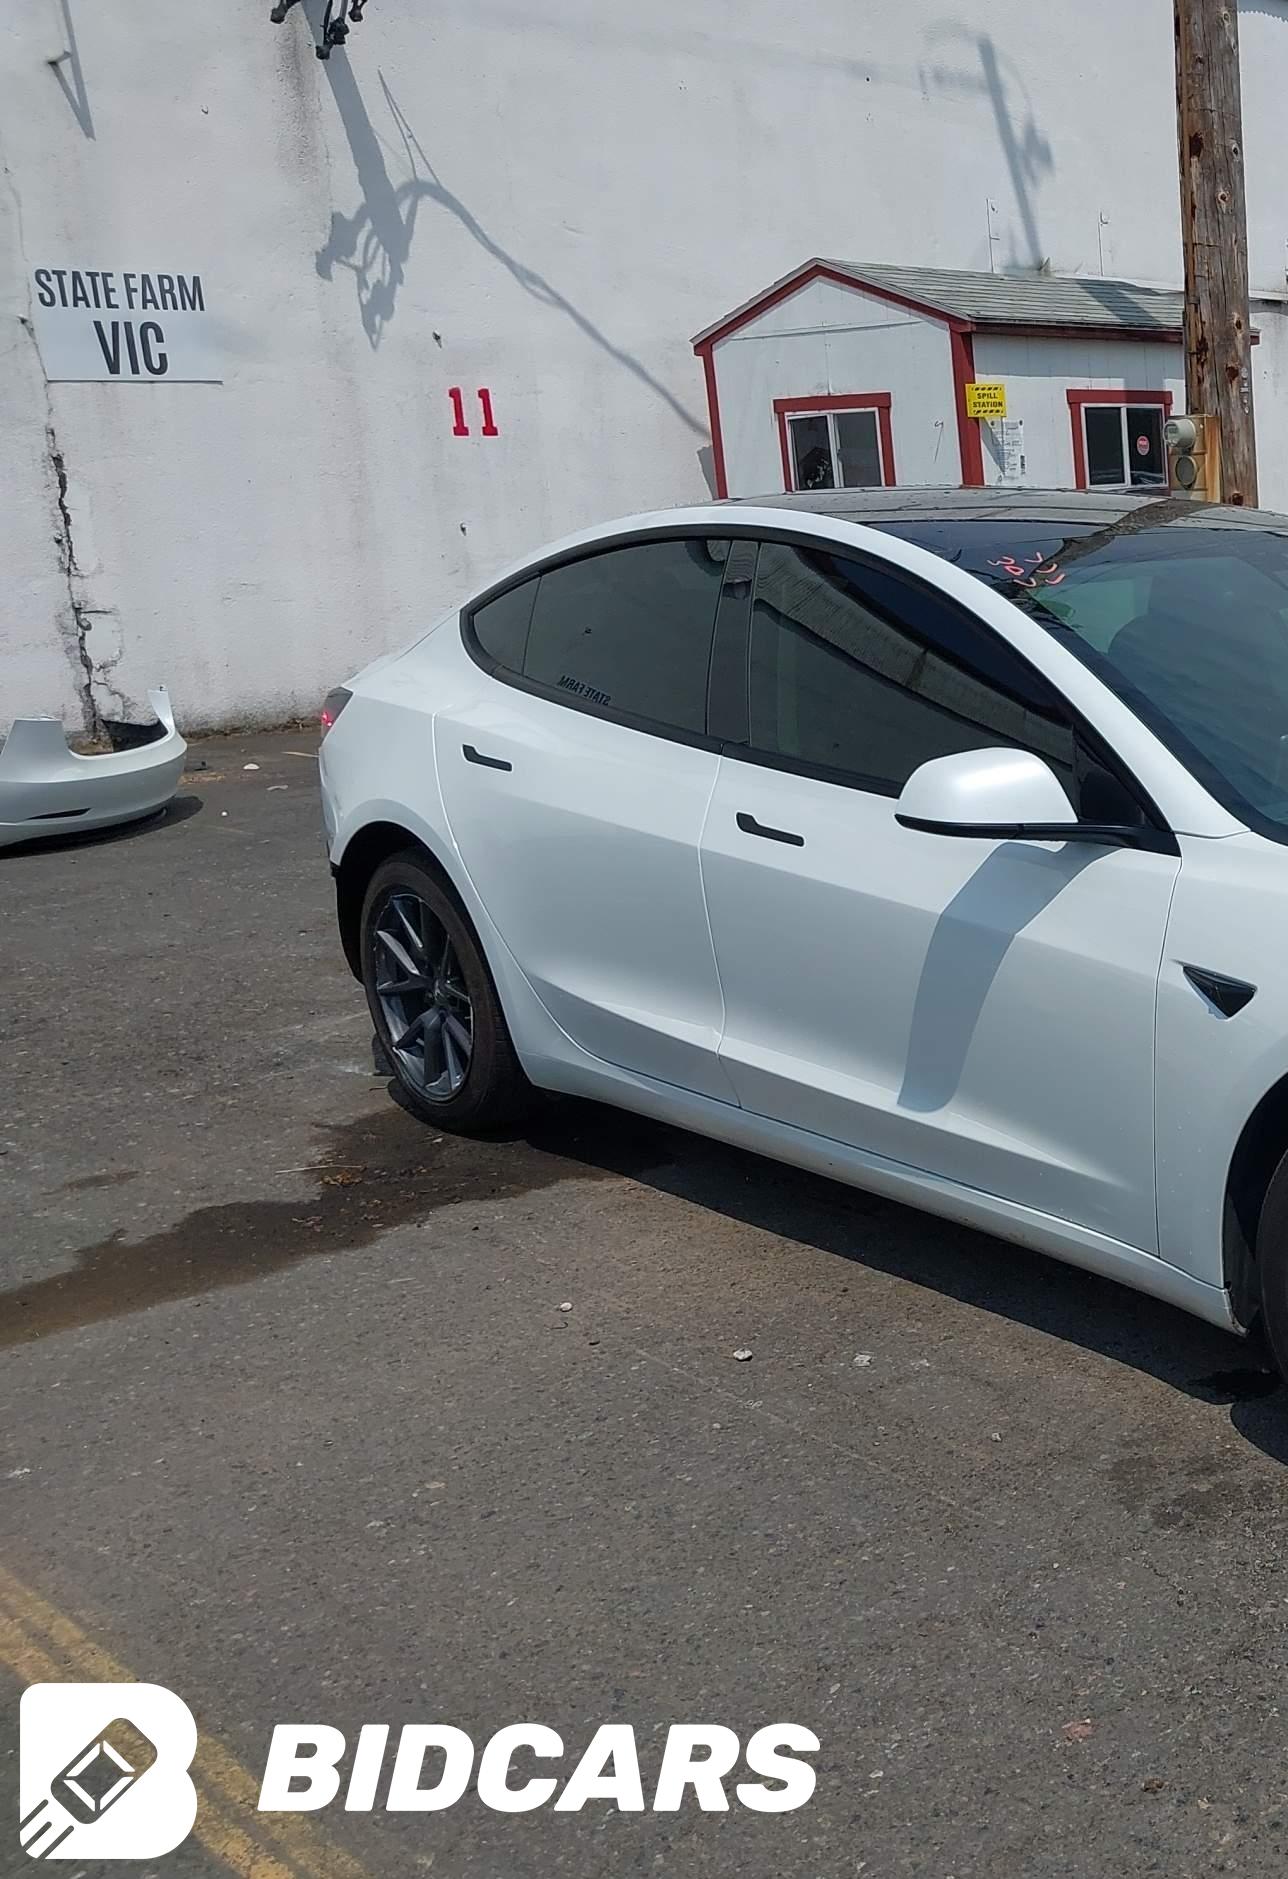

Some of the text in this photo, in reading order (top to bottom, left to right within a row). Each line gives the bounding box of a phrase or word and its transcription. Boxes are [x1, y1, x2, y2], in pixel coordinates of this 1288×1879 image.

[35, 269, 205, 311] STATE FARM
[93, 320, 168, 375] VIC
[449, 387, 498, 436] 11
